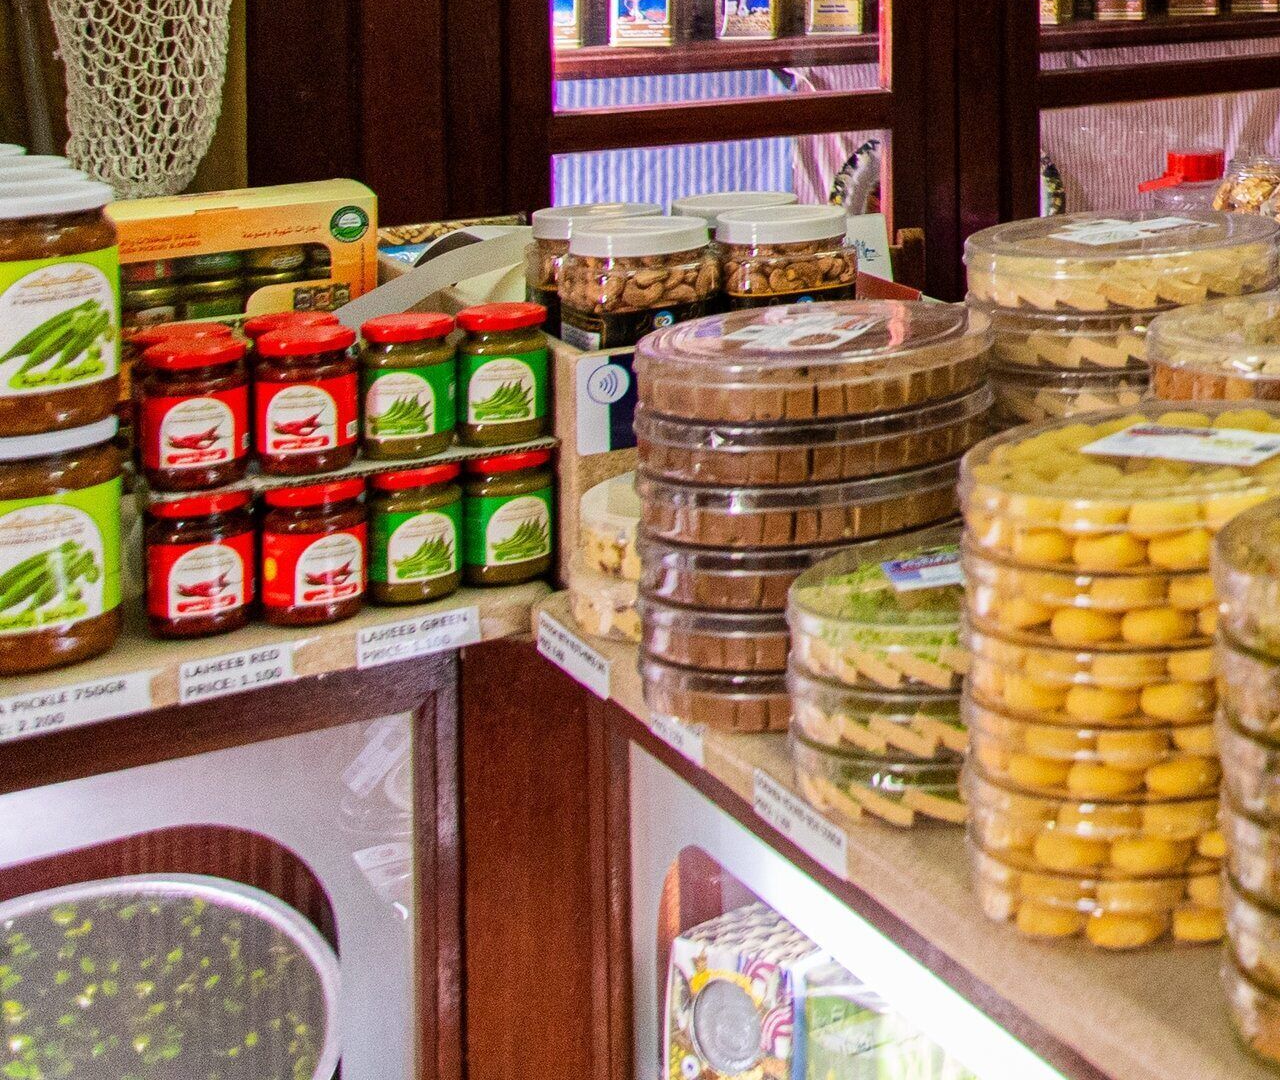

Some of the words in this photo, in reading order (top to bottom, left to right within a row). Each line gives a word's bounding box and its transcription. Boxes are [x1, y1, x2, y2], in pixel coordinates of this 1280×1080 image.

[362, 622, 416, 644] LAHEEB
[185, 656, 245, 678] LAHEEB
[249, 649, 280, 665] RED
[185, 677, 234, 697] PRICE:
[11, 693, 68, 713] PICKLE
